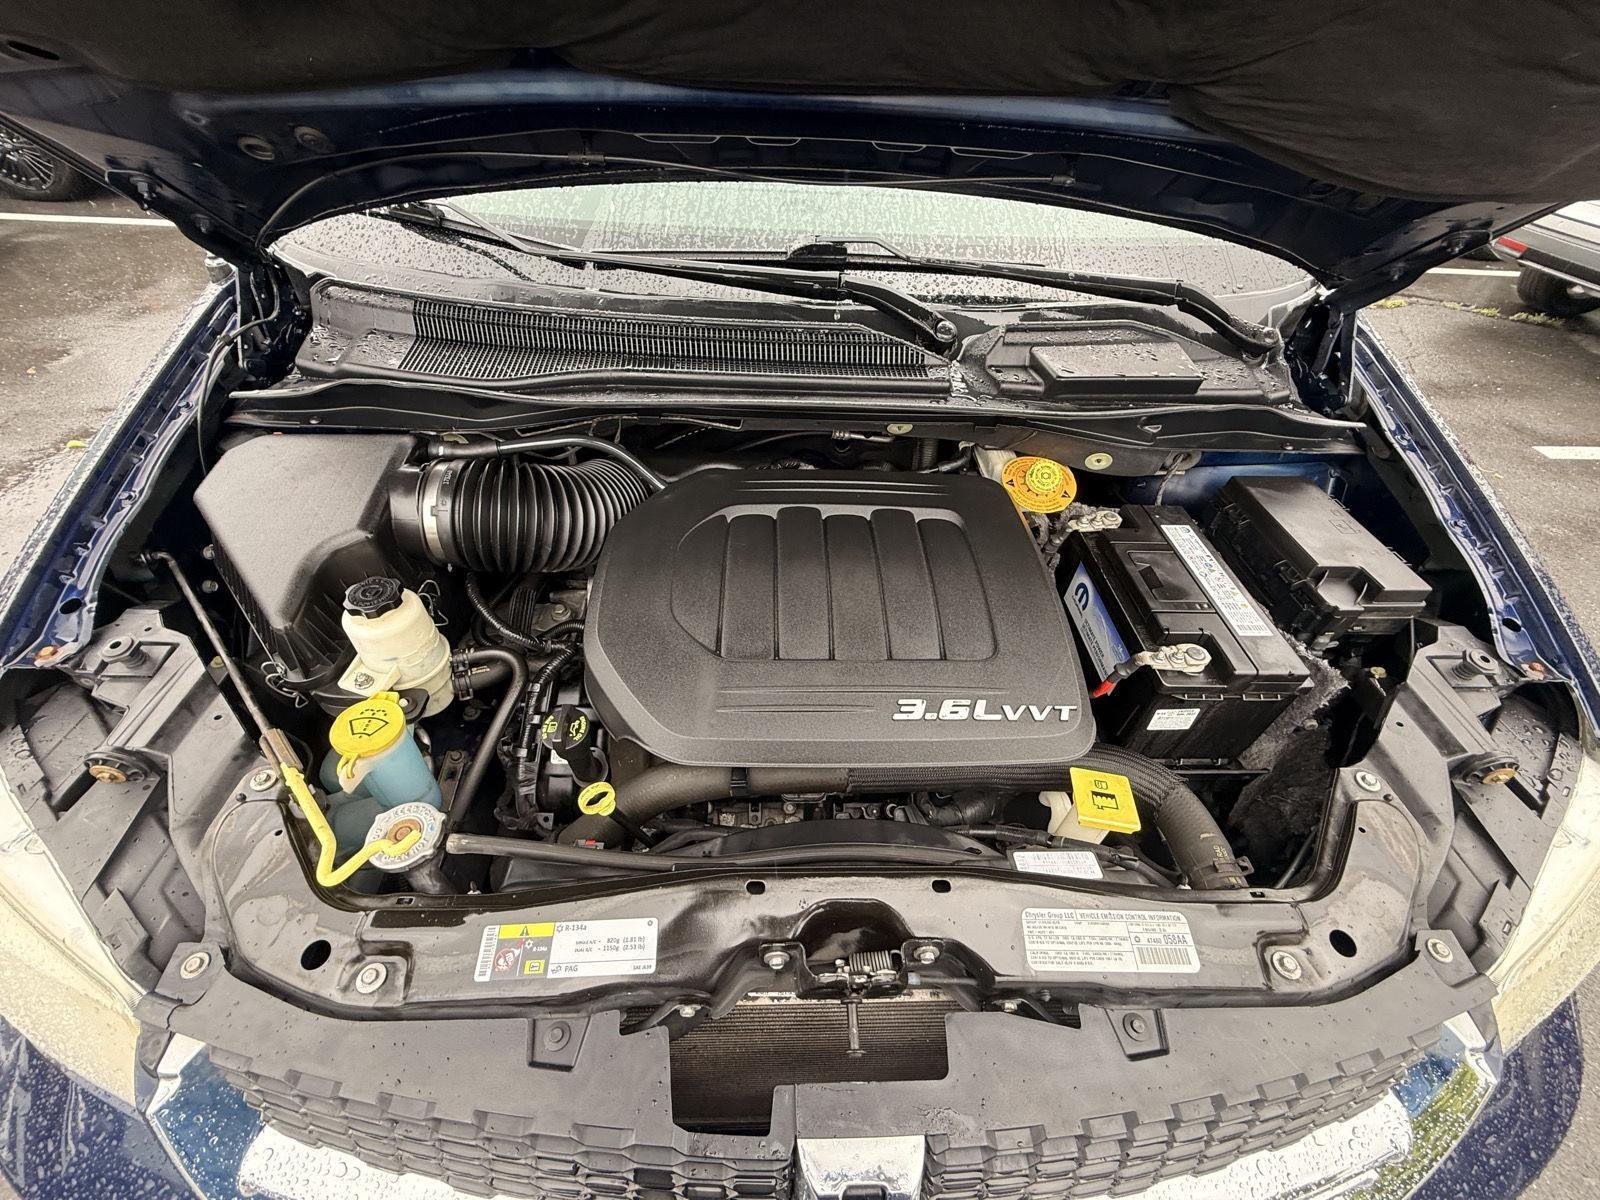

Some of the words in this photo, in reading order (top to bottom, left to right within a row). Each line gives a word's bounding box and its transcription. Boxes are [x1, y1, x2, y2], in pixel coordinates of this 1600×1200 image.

[892, 698, 1002, 721] 3.6L
[1002, 704, 1078, 721] VVT
[1025, 911, 1047, 920] Chrysler
[1047, 911, 1063, 920] Group
[1063, 911, 1075, 919] LLC
[1079, 912, 1100, 920] VEHICLE
[1101, 912, 1124, 920] EMISSION
[1125, 913, 1147, 921] CONTROL
[1149, 914, 1181, 922] INFORMATION
[564, 964, 579, 972] PAG
